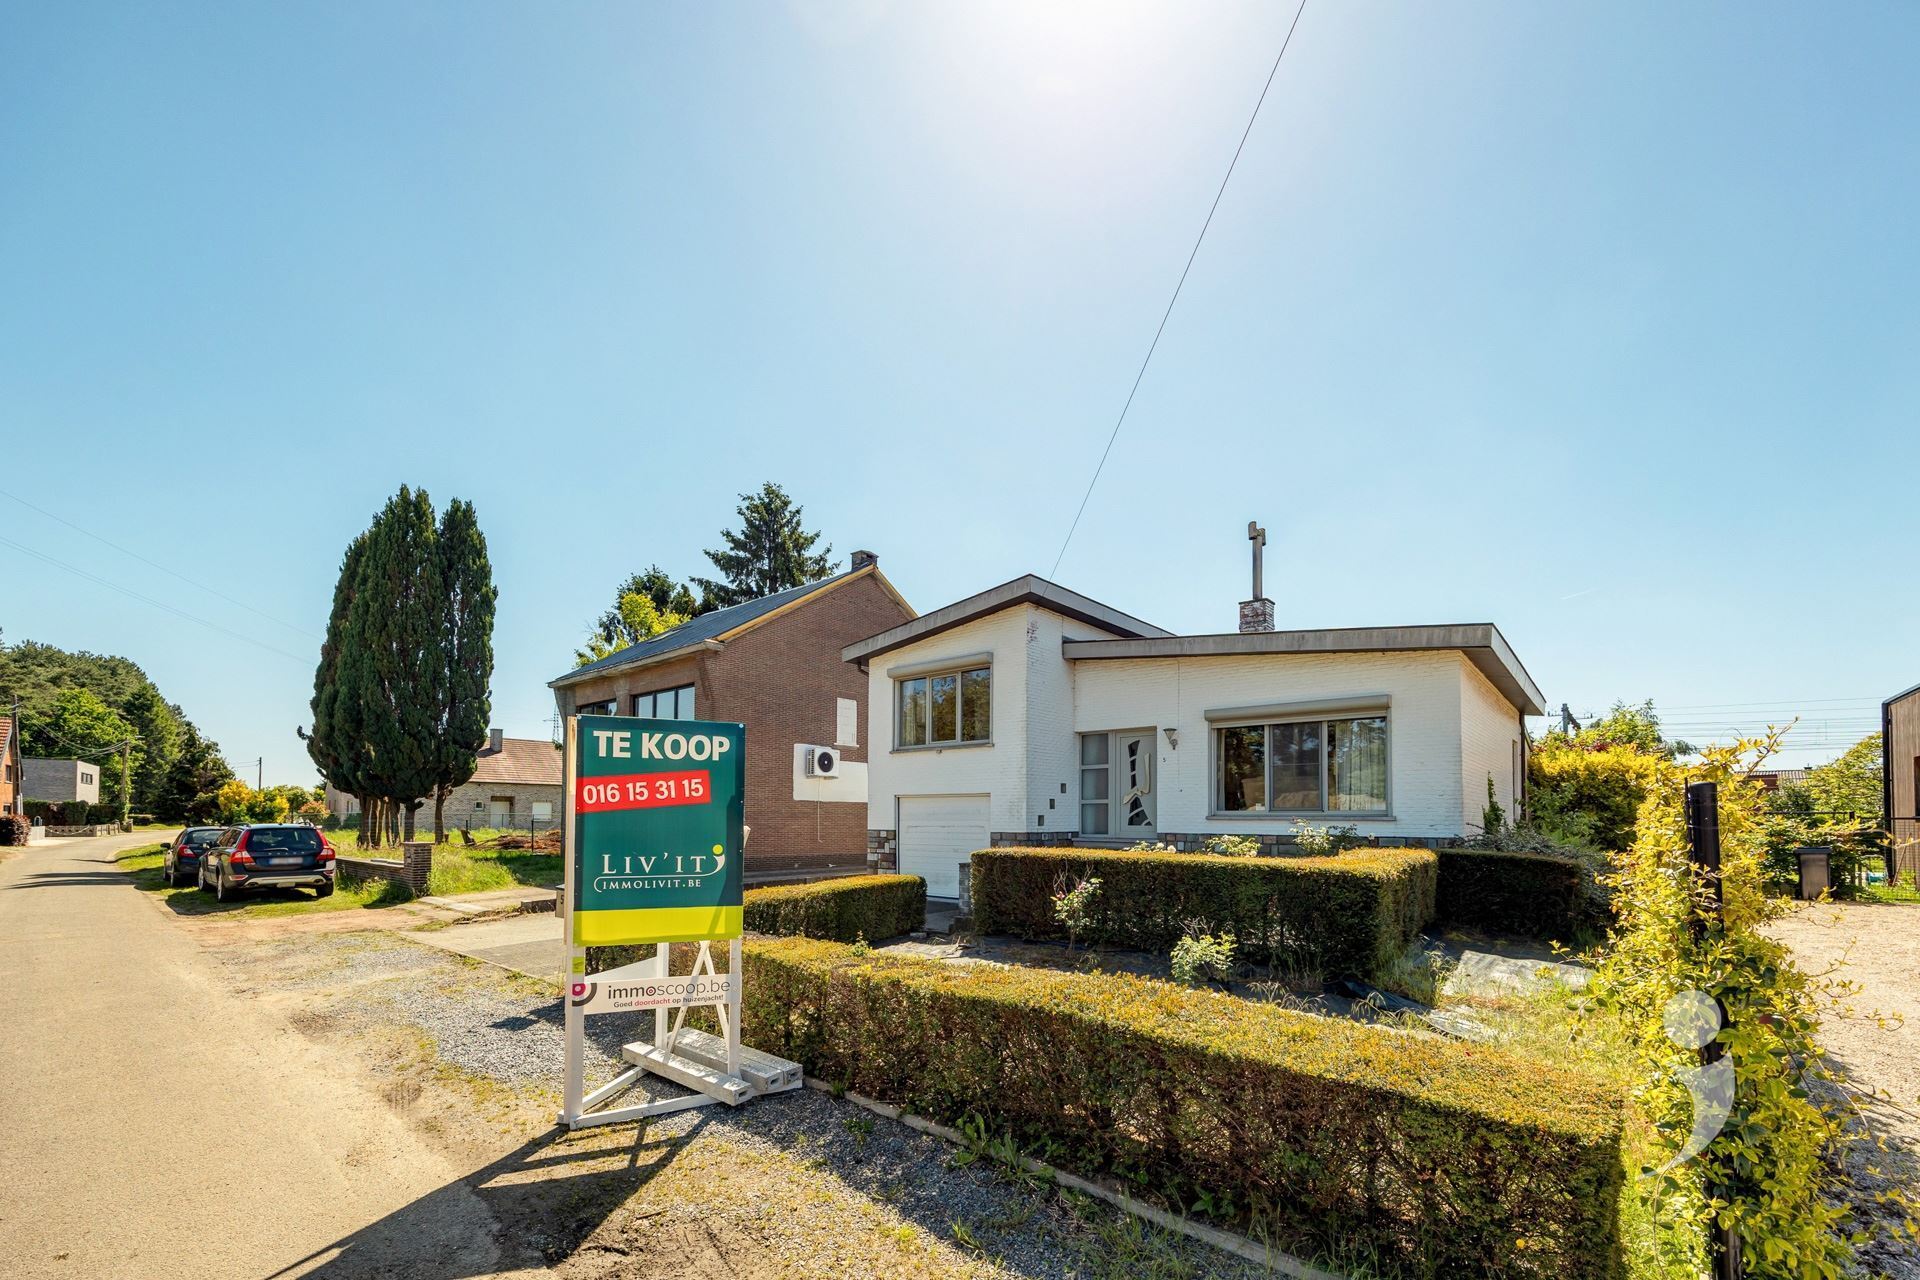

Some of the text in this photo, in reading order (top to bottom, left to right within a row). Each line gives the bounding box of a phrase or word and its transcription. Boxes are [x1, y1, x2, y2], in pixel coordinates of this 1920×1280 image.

[593, 731, 730, 760] TE KOOP
[583, 779, 704, 804] 016 15 31 15
[602, 853, 706, 873] LIV'IT
[603, 880, 701, 889] IMMOLIVIT.BE
[608, 979, 731, 999] immoscoop.be
[613, 994, 724, 1008] Goed doordacht op huizenjacht!
